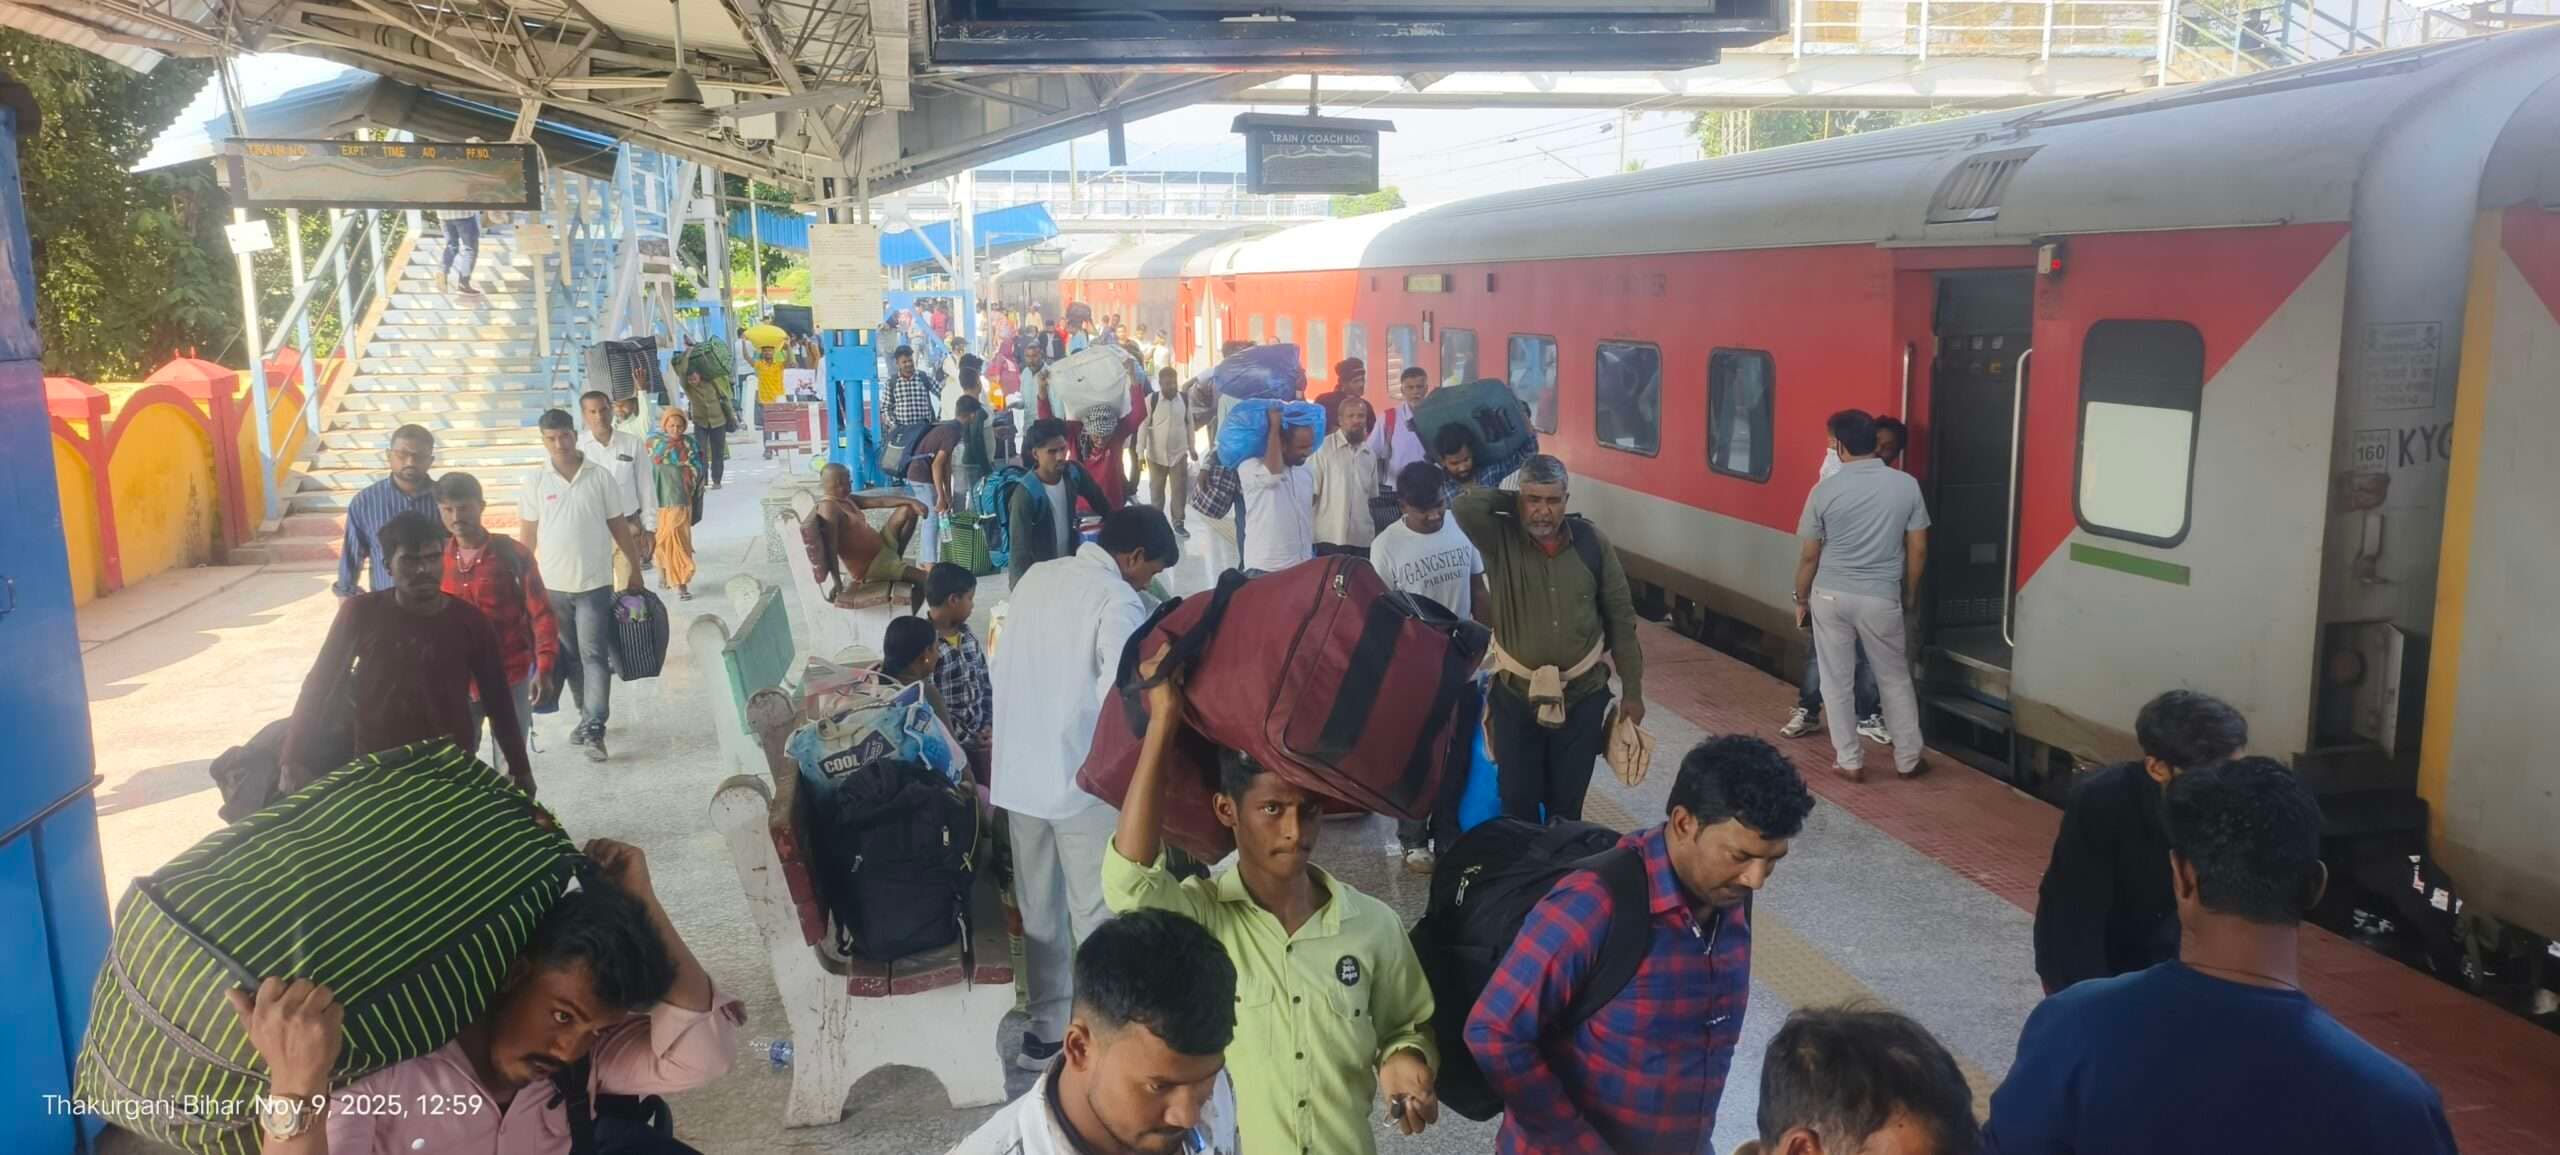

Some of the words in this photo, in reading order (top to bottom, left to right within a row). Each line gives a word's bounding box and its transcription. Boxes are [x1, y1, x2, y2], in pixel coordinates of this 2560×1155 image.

[1272, 134, 1298, 144] TRAIN
[1307, 133, 1343, 145] COACH
[381, 145, 407, 158] TIME
[2356, 444, 2385, 461] 160
[1404, 545, 1470, 585] GANGSTER'S
[1423, 568, 1463, 588] PARADISE
[823, 753, 861, 774] COOL
